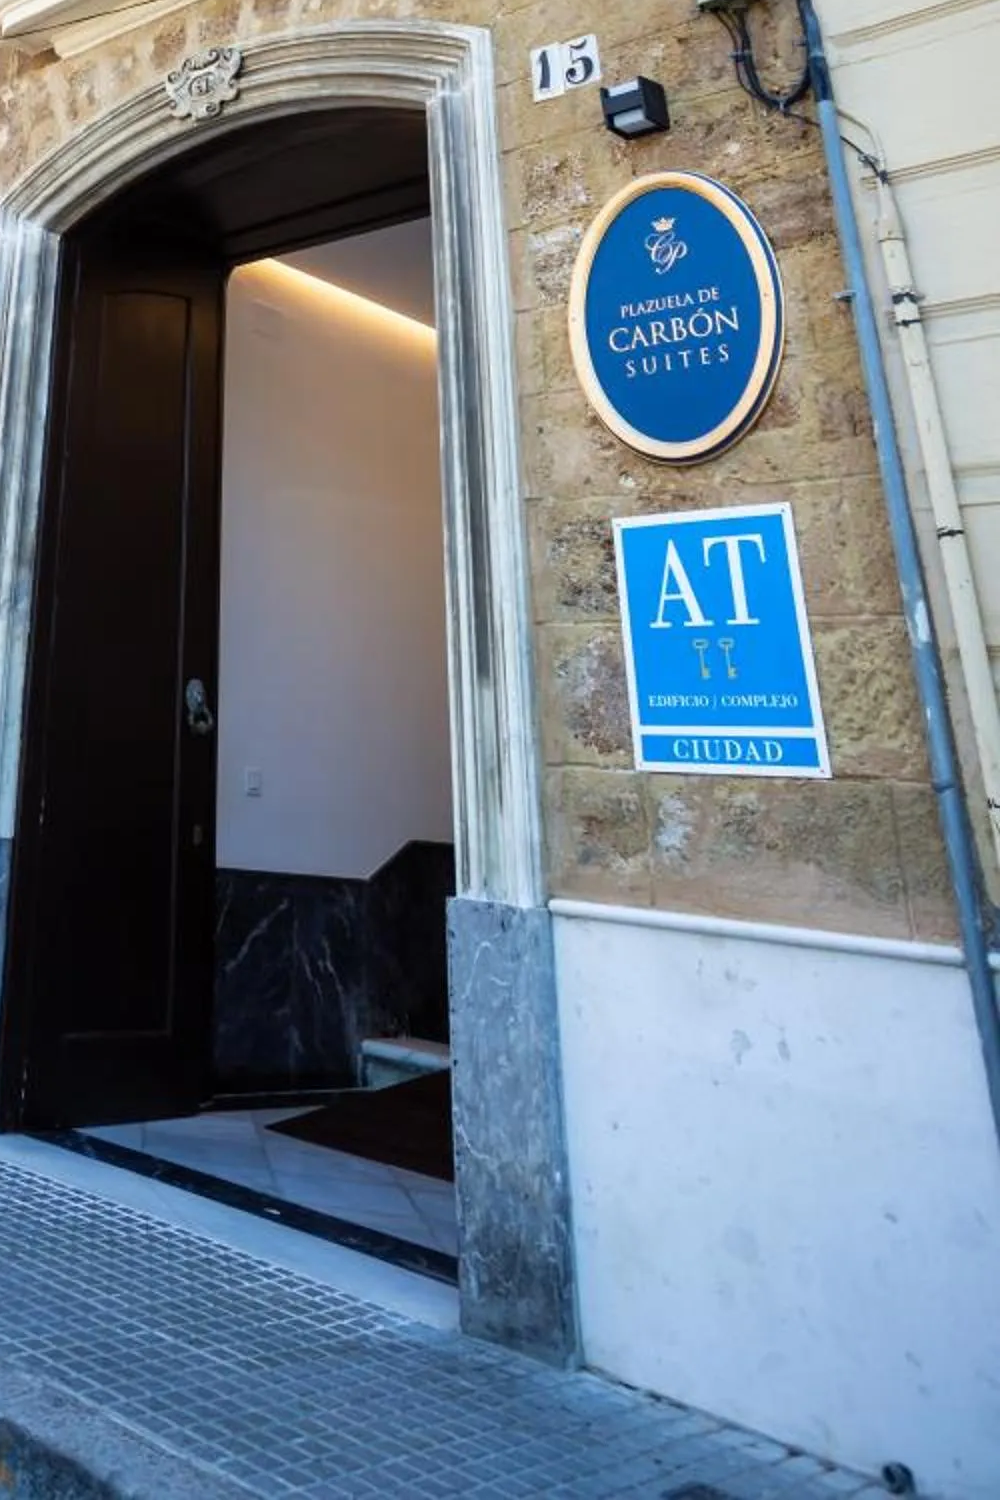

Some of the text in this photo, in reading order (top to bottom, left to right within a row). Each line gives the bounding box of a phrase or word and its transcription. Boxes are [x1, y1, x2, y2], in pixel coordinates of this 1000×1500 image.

[537, 38, 594, 88] 15
[620, 286, 721, 319] PLAZUELA DE
[608, 306, 739, 353] CARBÓN
[625, 343, 730, 378] SUITES
[649, 533, 767, 628] AT
[648, 694, 798, 709] EDIFICIO COMPLEJO
[672, 739, 783, 762] CIUDAD
